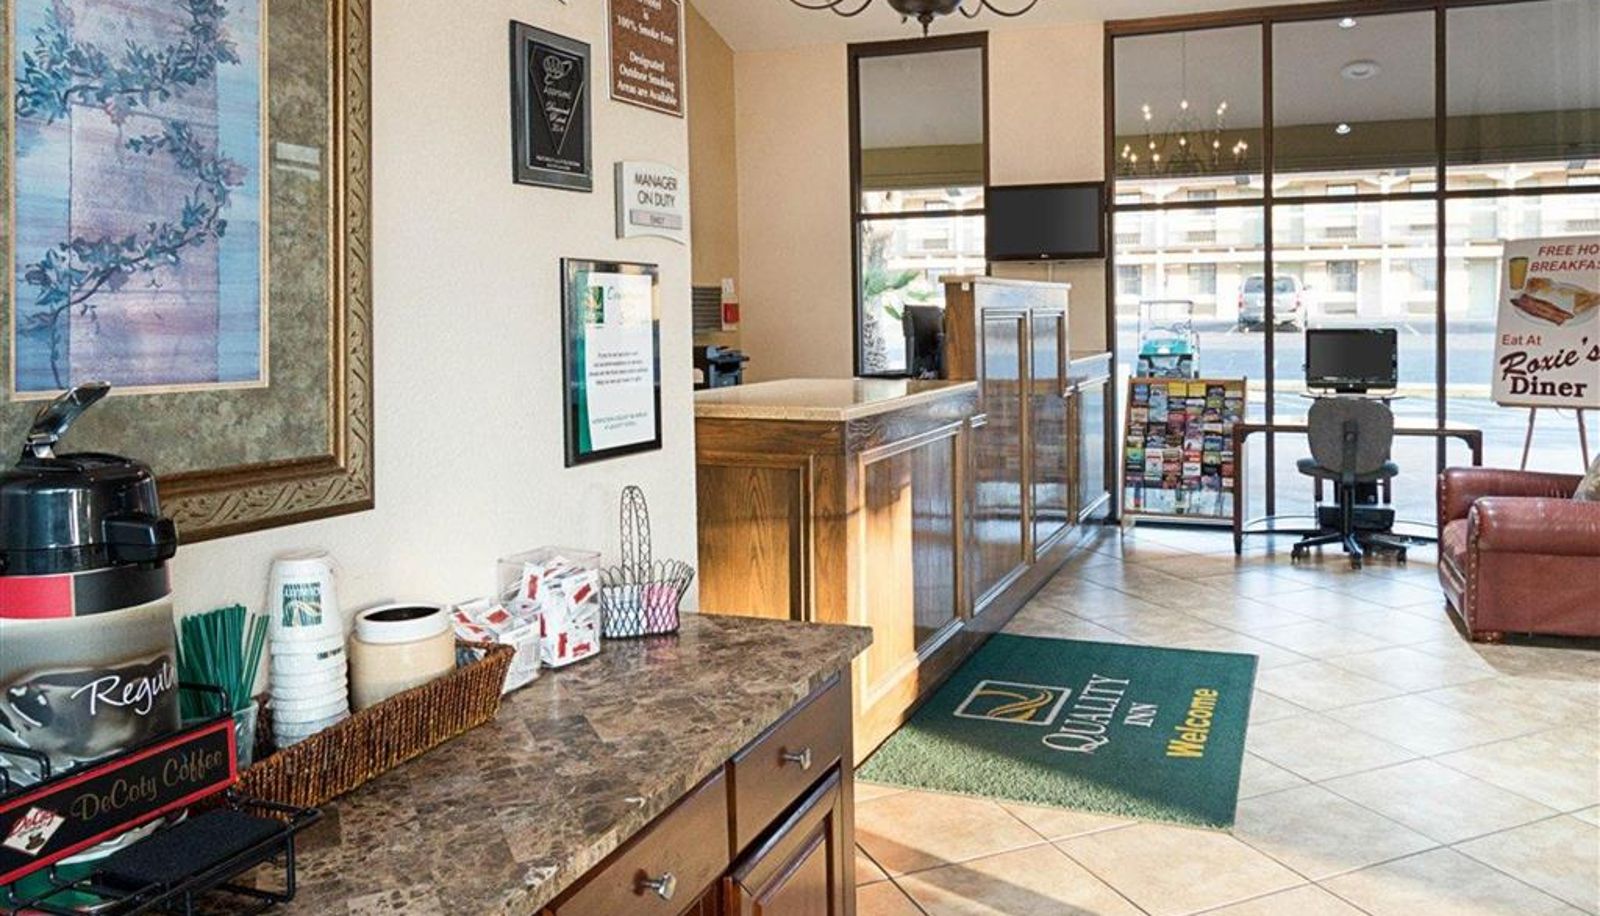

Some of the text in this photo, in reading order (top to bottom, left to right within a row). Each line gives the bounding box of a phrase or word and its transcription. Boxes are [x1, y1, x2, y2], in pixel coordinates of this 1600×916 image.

[617, 14, 674, 46] 100% Smoke Free
[629, 50, 665, 73] Designated
[619, 63, 675, 94] Outdoor Smoking
[634, 172, 678, 191] MANAGER
[637, 190, 676, 208] ON DUTY
[1538, 243, 1600, 256] FREE HO
[1502, 334, 1542, 346] Eat At
[1499, 336, 1600, 381] Roxie's
[1510, 375, 1588, 398] Diner
[1041, 673, 1131, 754] QUALITY
[1122, 701, 1160, 728] INN
[1165, 687, 1219, 757] Welcome
[71, 750, 223, 821] DeCoty Coffee
